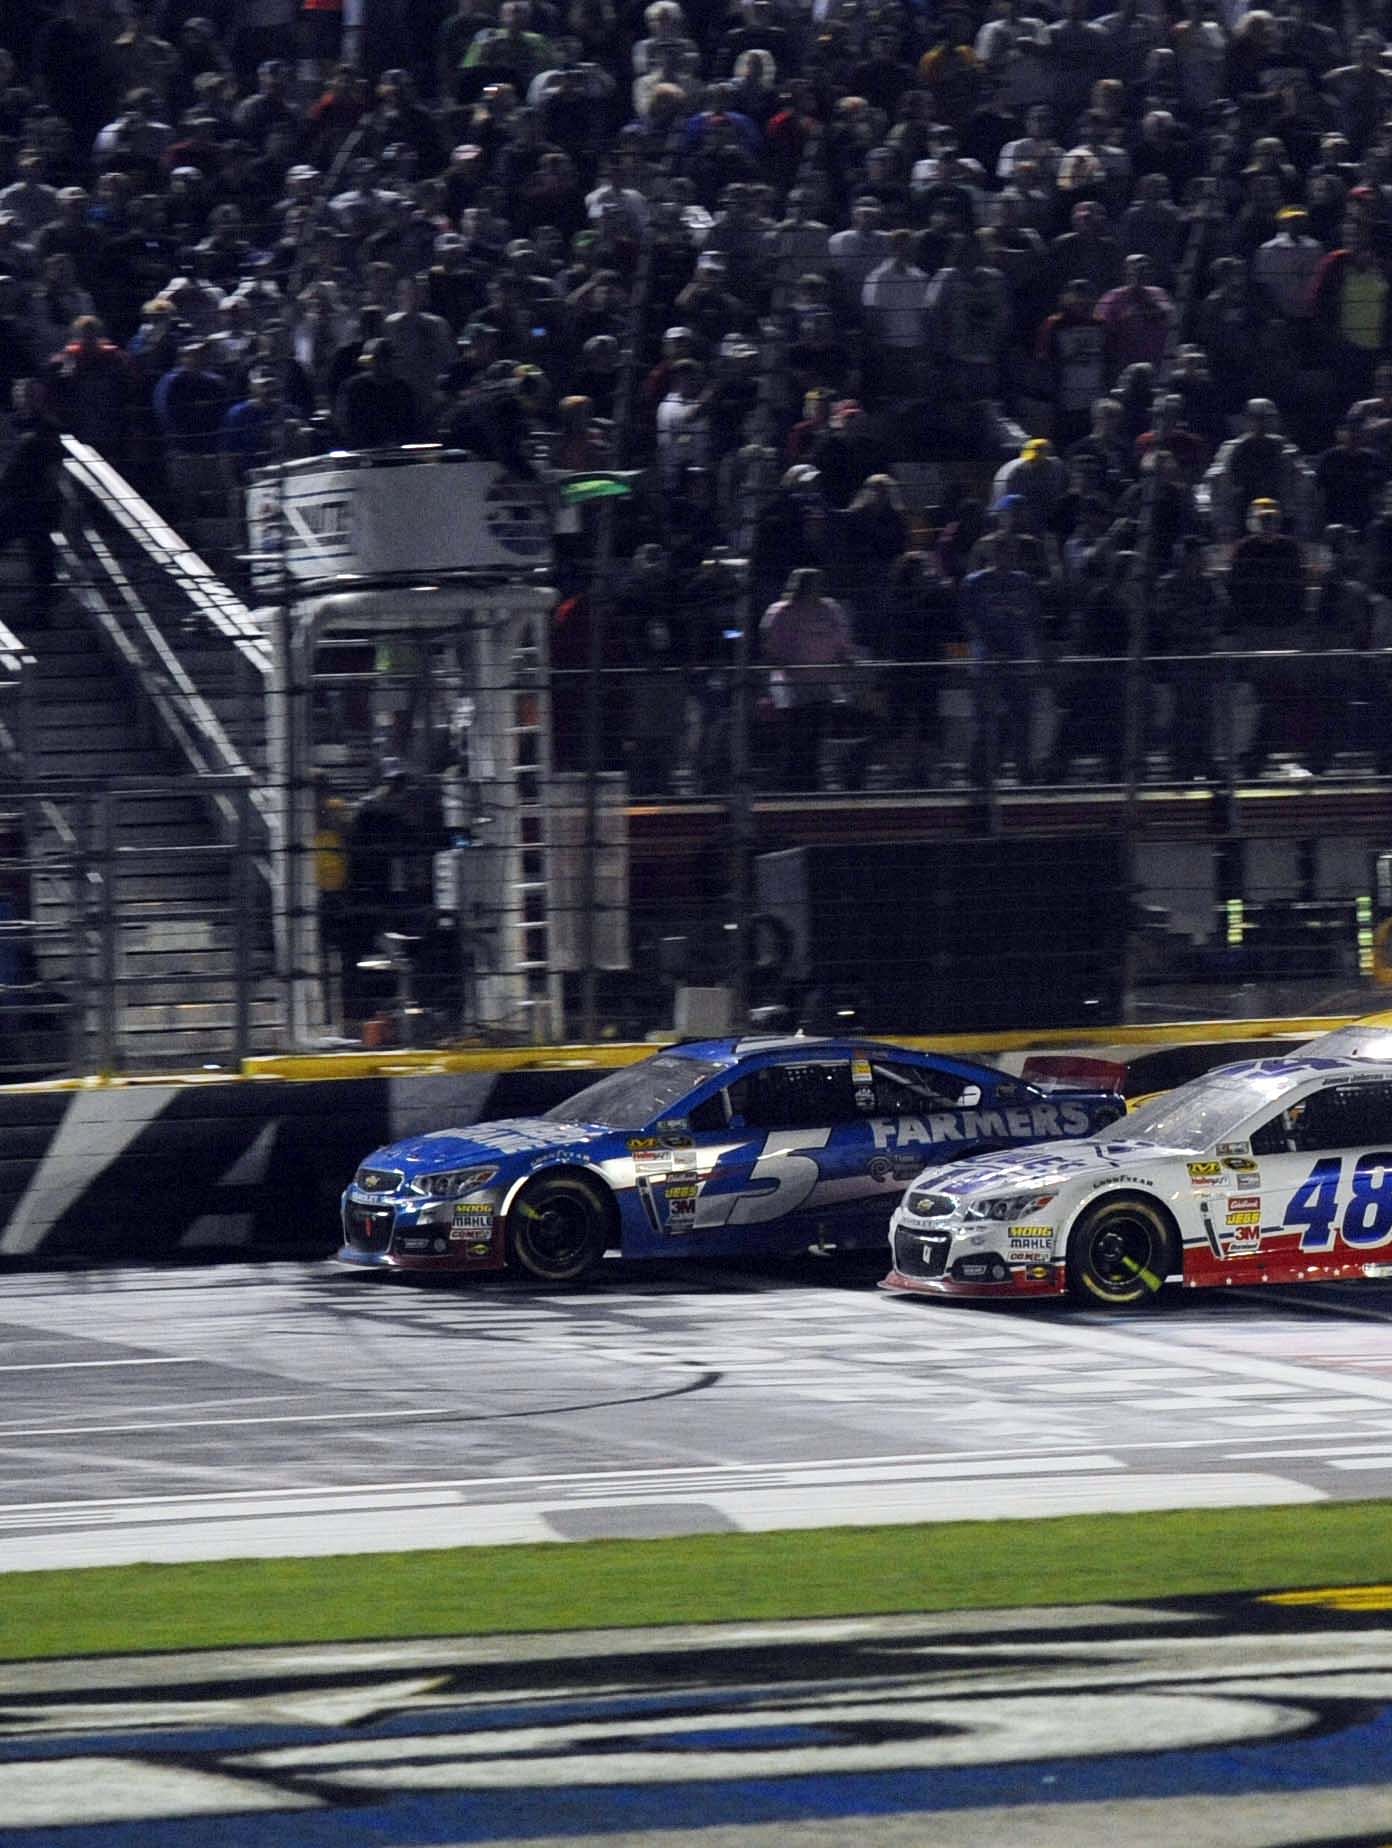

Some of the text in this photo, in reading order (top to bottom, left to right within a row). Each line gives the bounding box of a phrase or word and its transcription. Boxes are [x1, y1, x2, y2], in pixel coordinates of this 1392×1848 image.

[869, 1101, 1089, 1149] FARMERS
[692, 1127, 832, 1228] 5
[671, 1199, 696, 1214] 3M
[1011, 1226, 1052, 1237] MOOG
[1235, 1226, 1260, 1241] 3M
[1010, 1238, 1052, 1249] MAHLE
